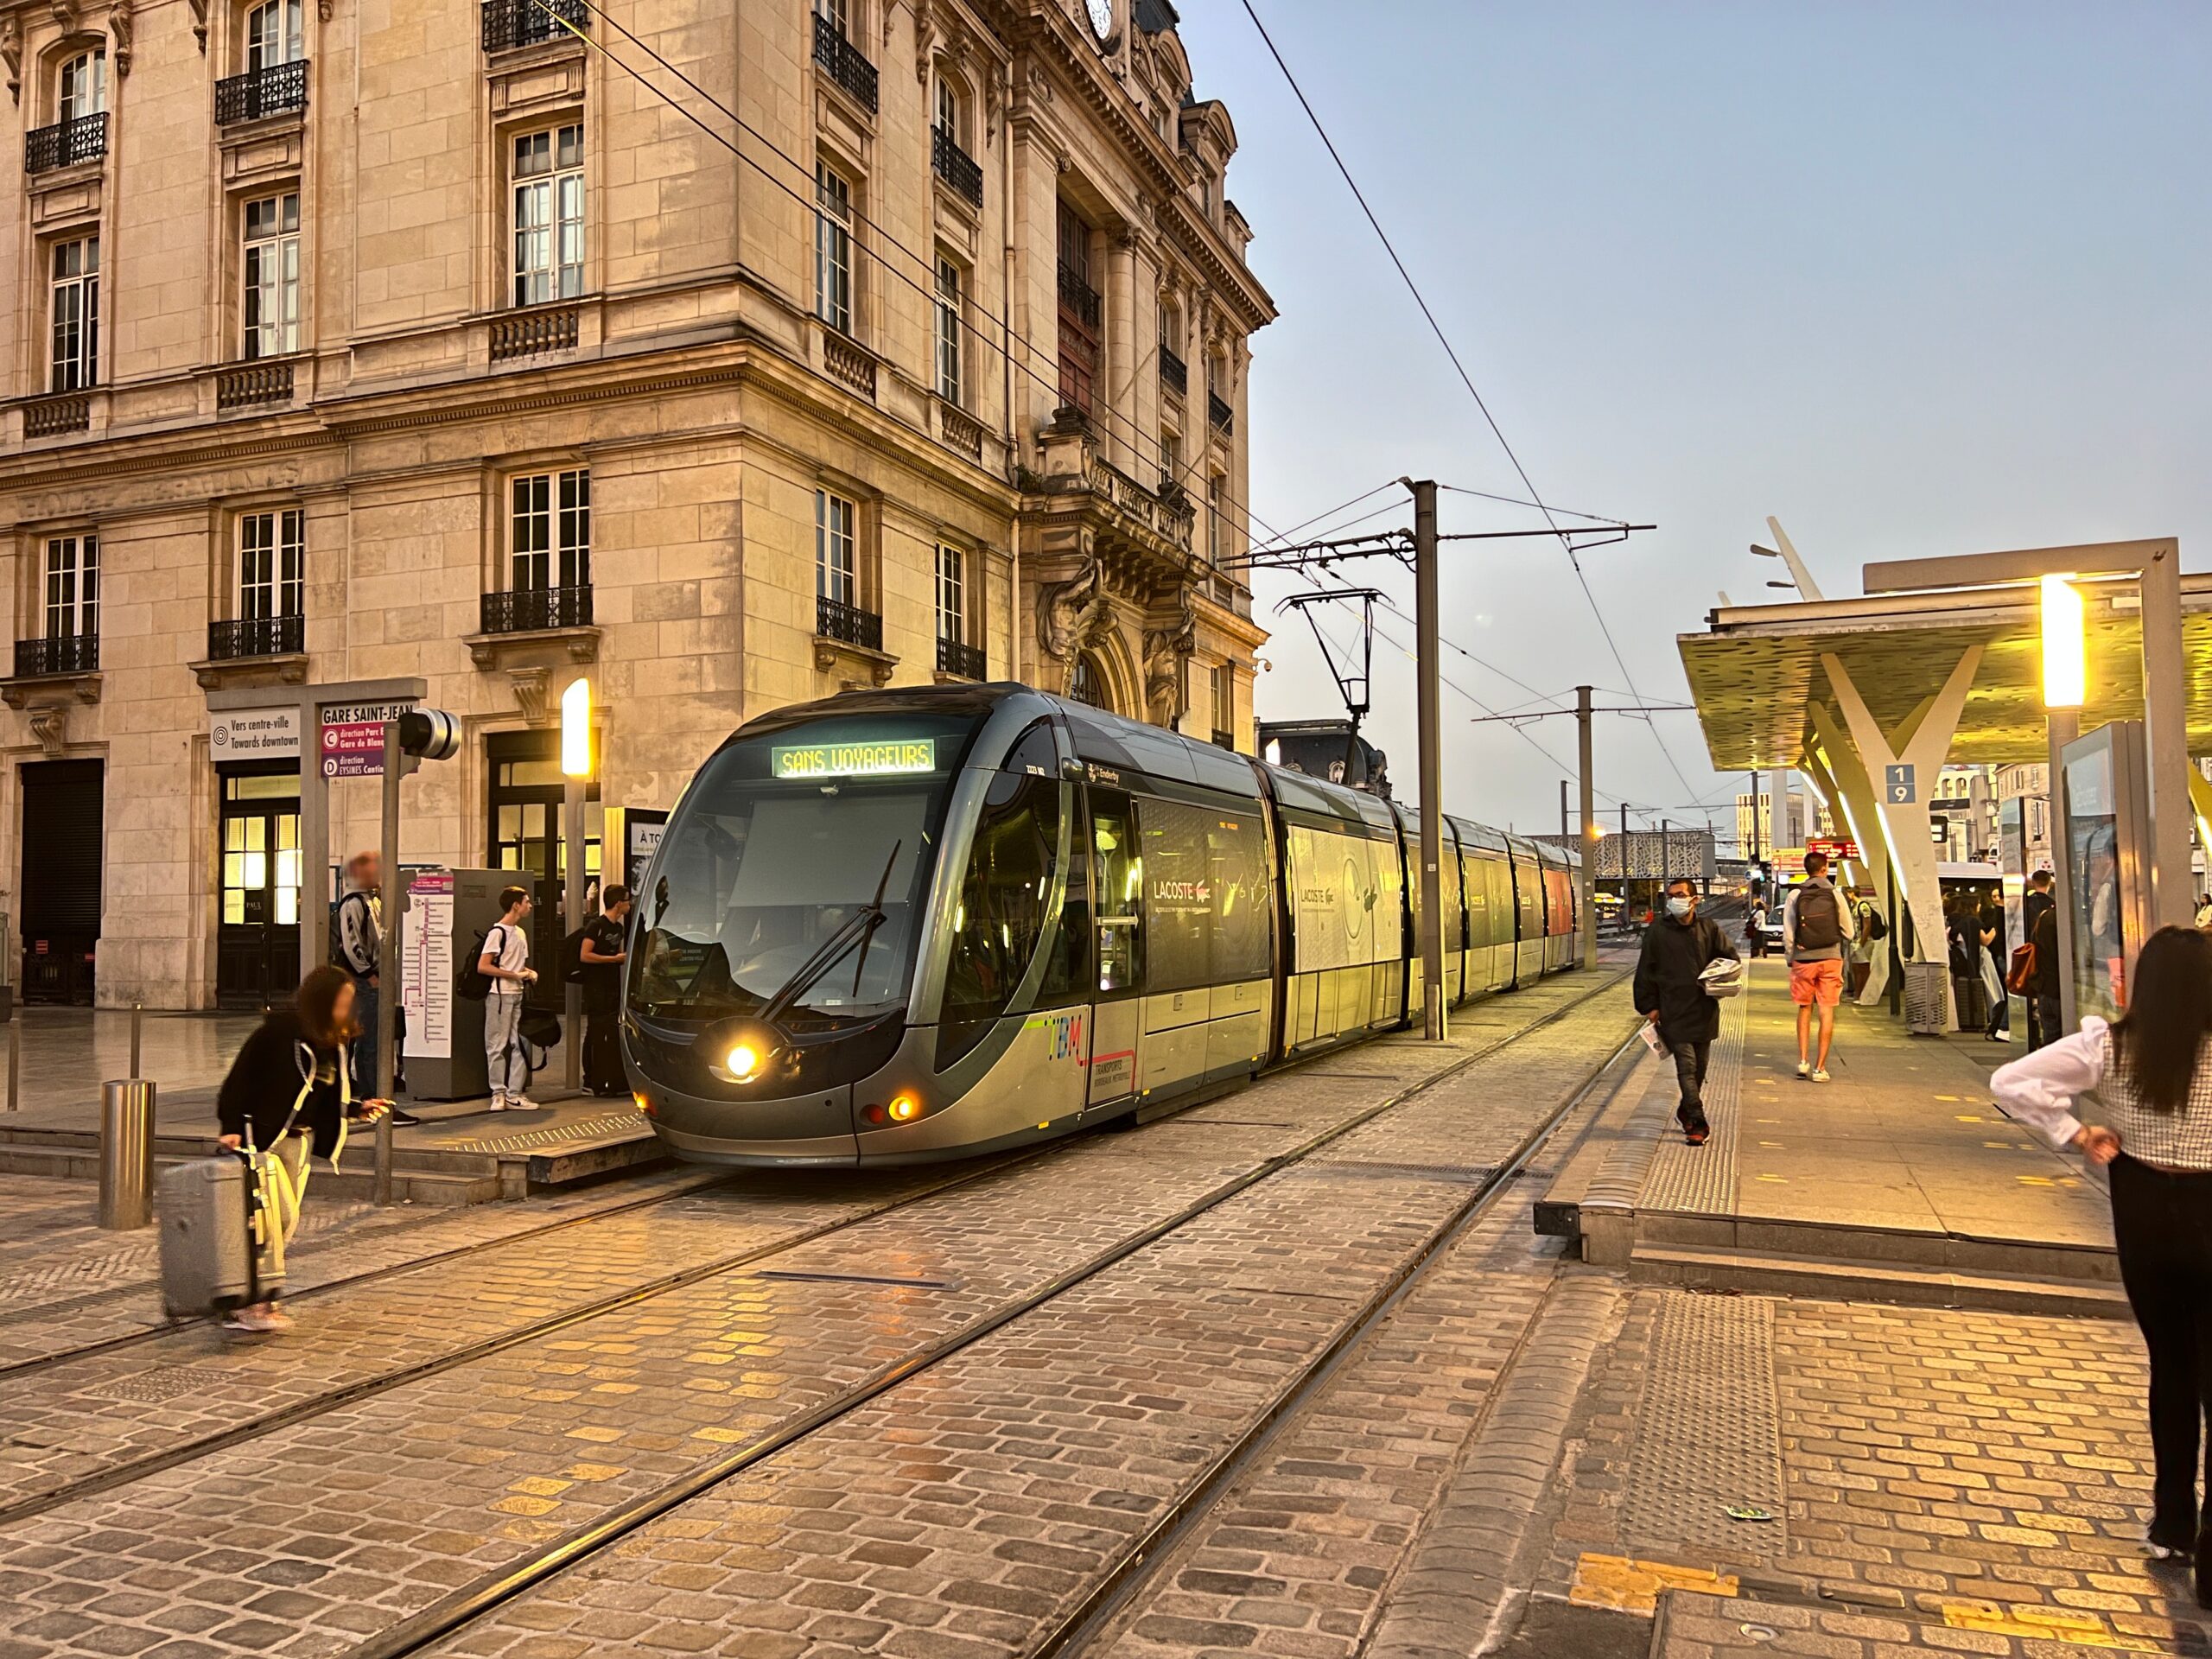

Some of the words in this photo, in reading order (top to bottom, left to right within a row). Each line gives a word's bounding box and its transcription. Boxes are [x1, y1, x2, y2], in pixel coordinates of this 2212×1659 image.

[231, 719, 246, 731] Vers
[248, 715, 289, 730] centre-ville
[323, 709, 351, 724] GARE
[340, 728, 365, 739] direction
[365, 728, 379, 737] Parc
[231, 734, 260, 749] Towards
[262, 734, 299, 747] downtown
[340, 740, 356, 748] Gare
[357, 738, 365, 747] de
[366, 738, 385, 748] Blanq
[340, 755, 365, 766] direction
[782, 750, 826, 775] SANS
[830, 745, 930, 772] VOYAGEURS
[339, 766, 362, 776] EYSINES
[363, 765, 385, 774] Cantin
[1894, 766, 1904, 782] 1
[1894, 786, 1908, 802] 9
[640, 830, 647, 843] À
[1154, 880, 1193, 899] LACOSTE
[1300, 888, 1325, 903] LACOSTE
[1044, 1014, 1083, 1064] TBM
[1095, 1059, 1123, 1076] TRANSPORTS
